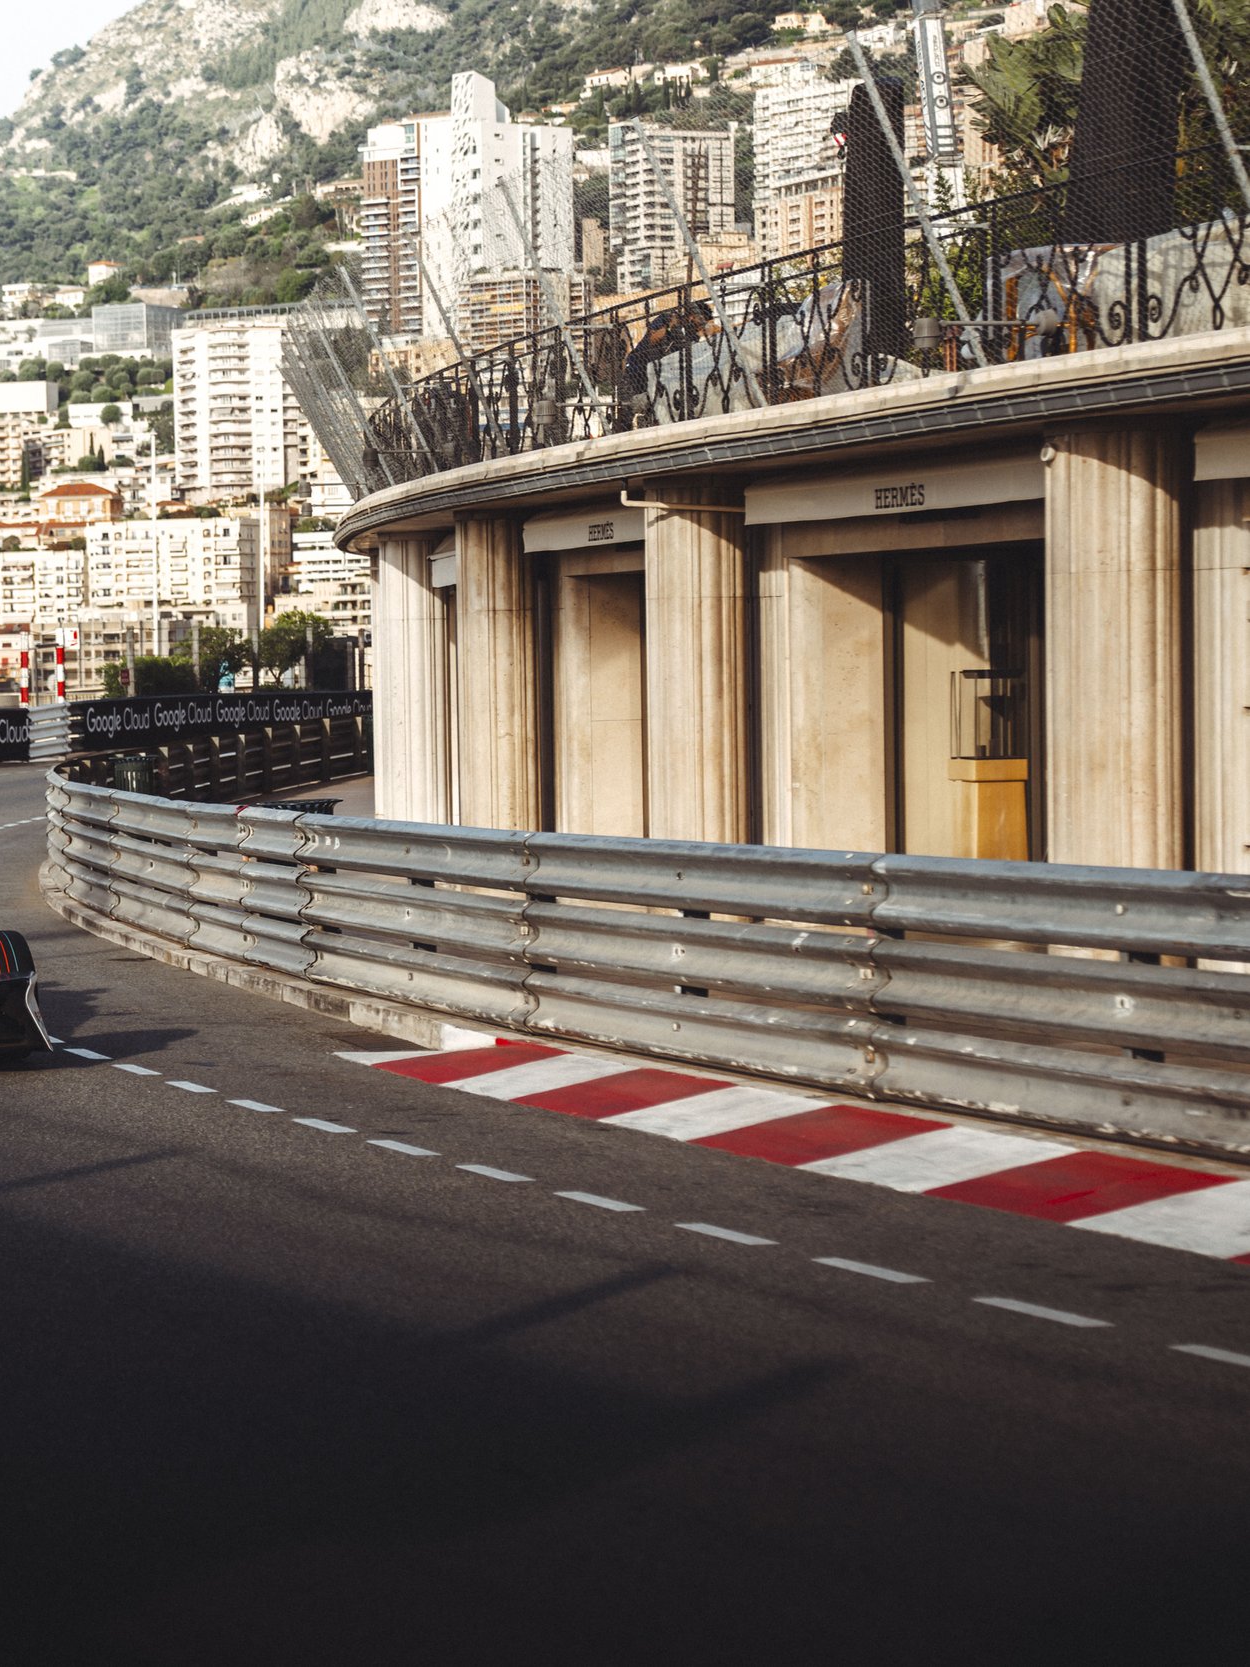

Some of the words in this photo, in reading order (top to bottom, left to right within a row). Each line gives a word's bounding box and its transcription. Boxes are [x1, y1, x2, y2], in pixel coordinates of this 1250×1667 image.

[874, 482, 925, 509] HERMÈS
[87, 707, 122, 738] Google
[123, 707, 150, 731] Cloud
[154, 702, 186, 732] Google
[188, 701, 212, 724] Cloud
[216, 700, 246, 728] Google
[247, 700, 270, 721] Cloud
